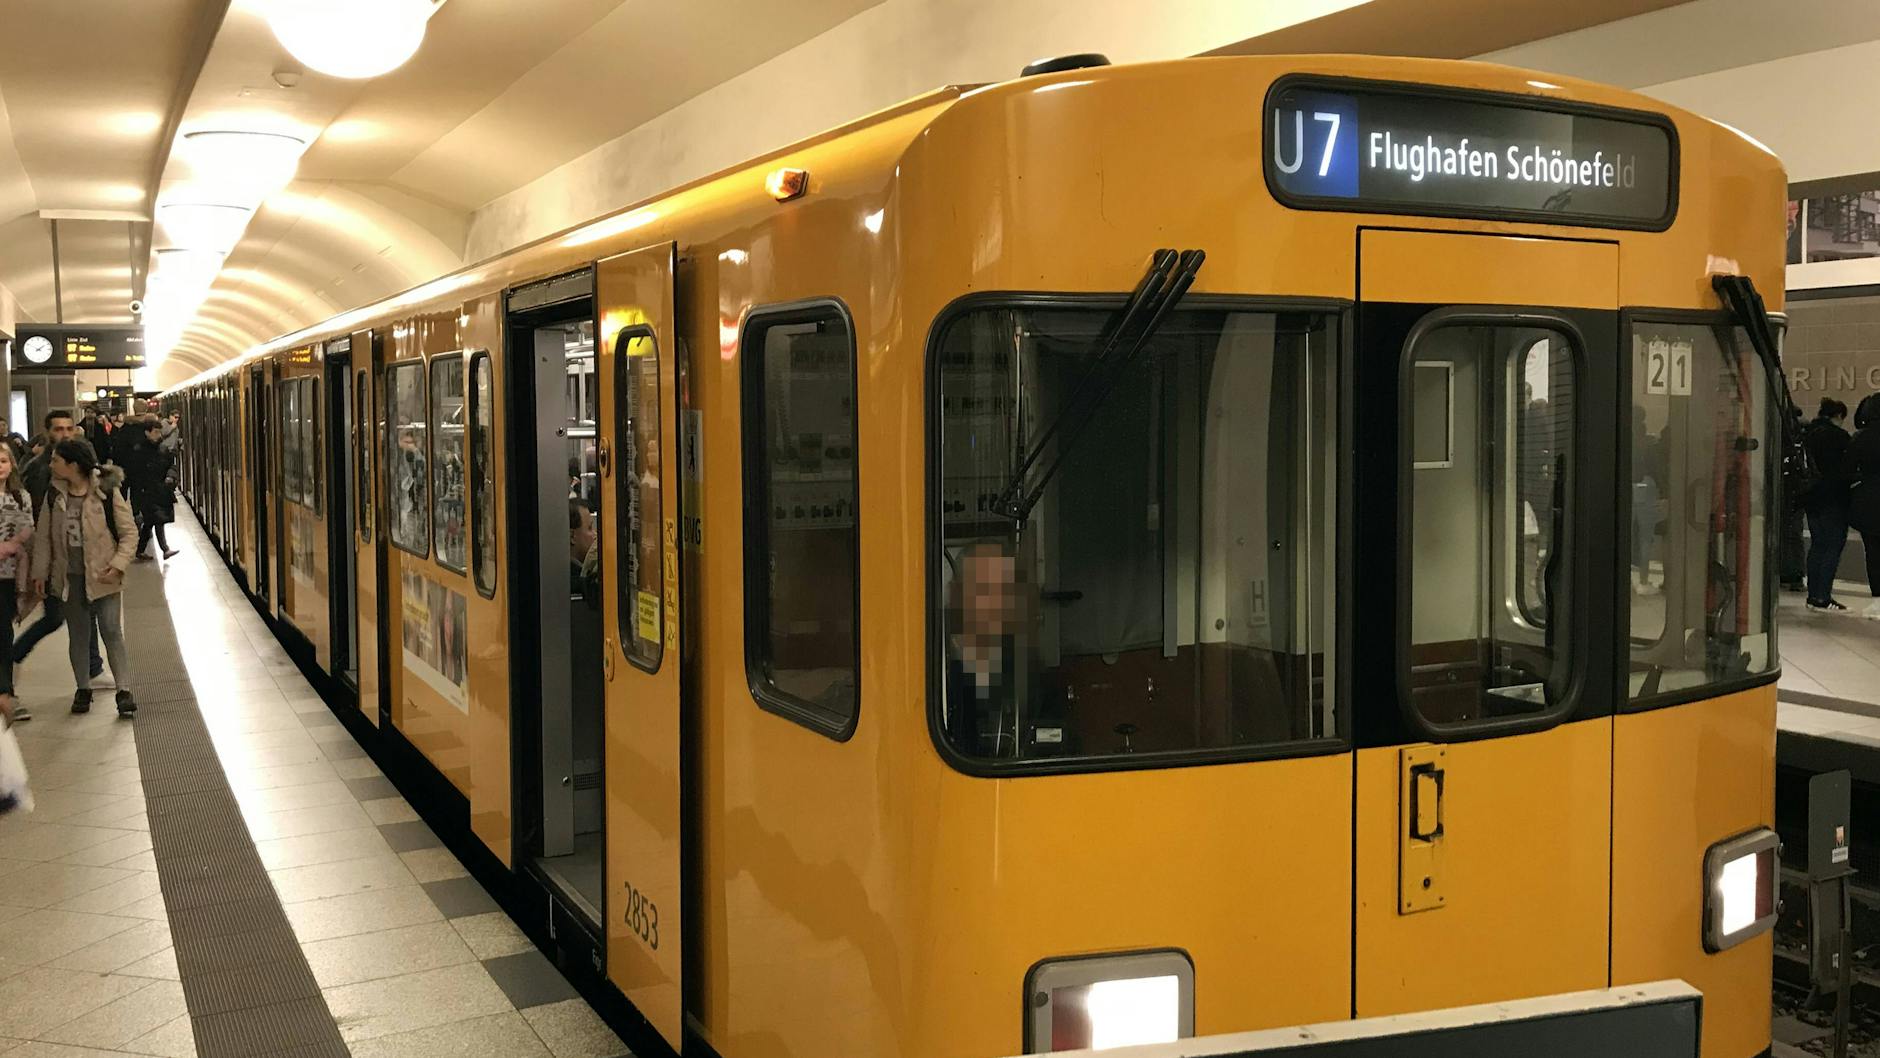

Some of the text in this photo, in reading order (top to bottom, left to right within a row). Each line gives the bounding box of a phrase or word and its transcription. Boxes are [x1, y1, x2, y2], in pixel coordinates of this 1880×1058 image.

[1368, 131, 1499, 182] Flughafen
[1505, 145, 1637, 190] Schönefeld
[1651, 353, 1686, 388] 21
[623, 881, 659, 950] 2853
